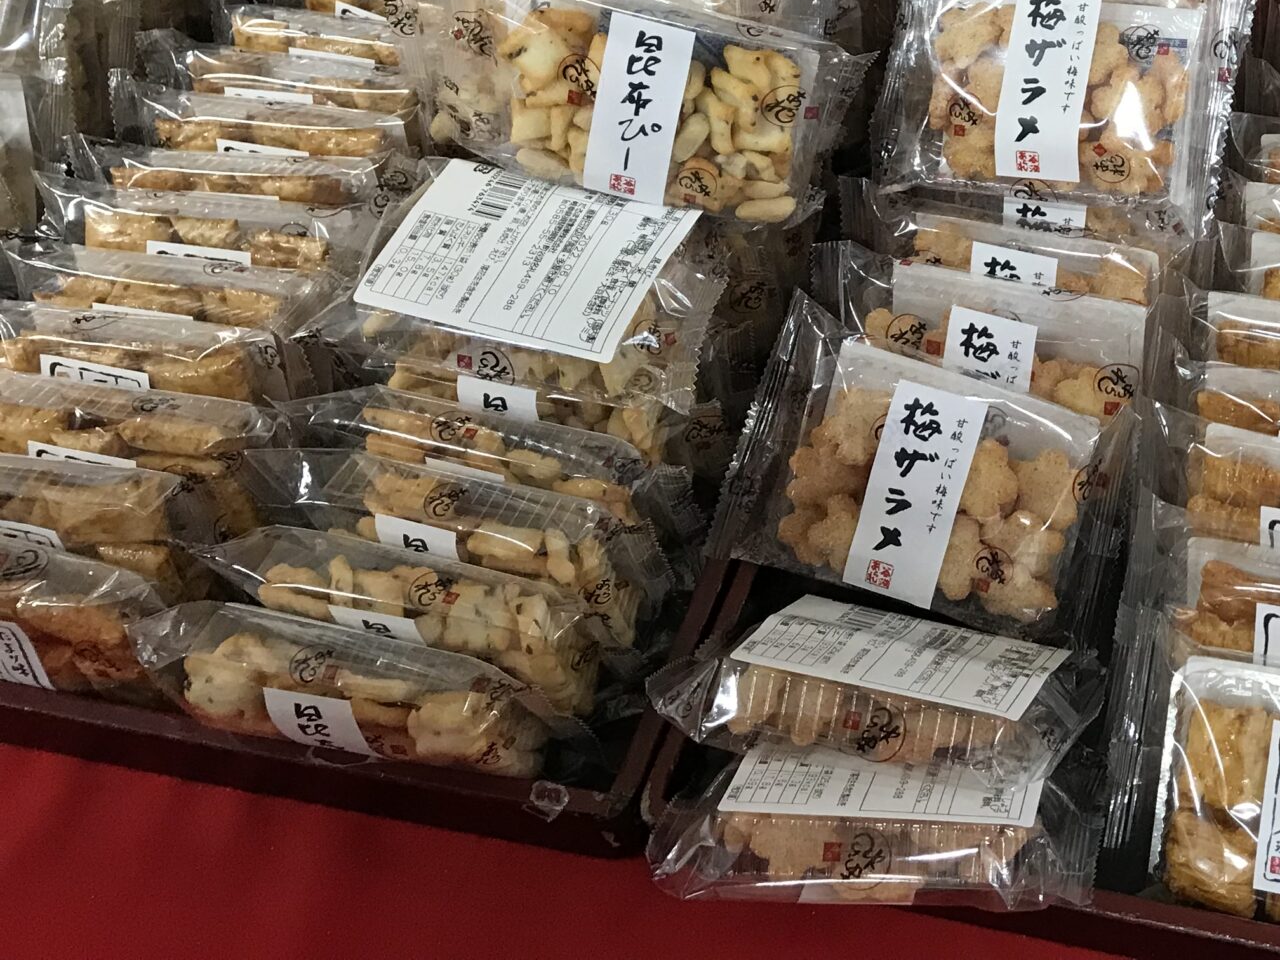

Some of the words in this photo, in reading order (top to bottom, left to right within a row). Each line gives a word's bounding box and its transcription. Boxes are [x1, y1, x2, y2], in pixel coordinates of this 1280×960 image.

[618, 30, 664, 171] 昆布ぴー
[1060, 2, 1090, 114] 甘酸っぱい梅味です
[872, 397, 943, 552] 梅ザラメ
[926, 418, 968, 534] 甘酸っぱい梅味です
